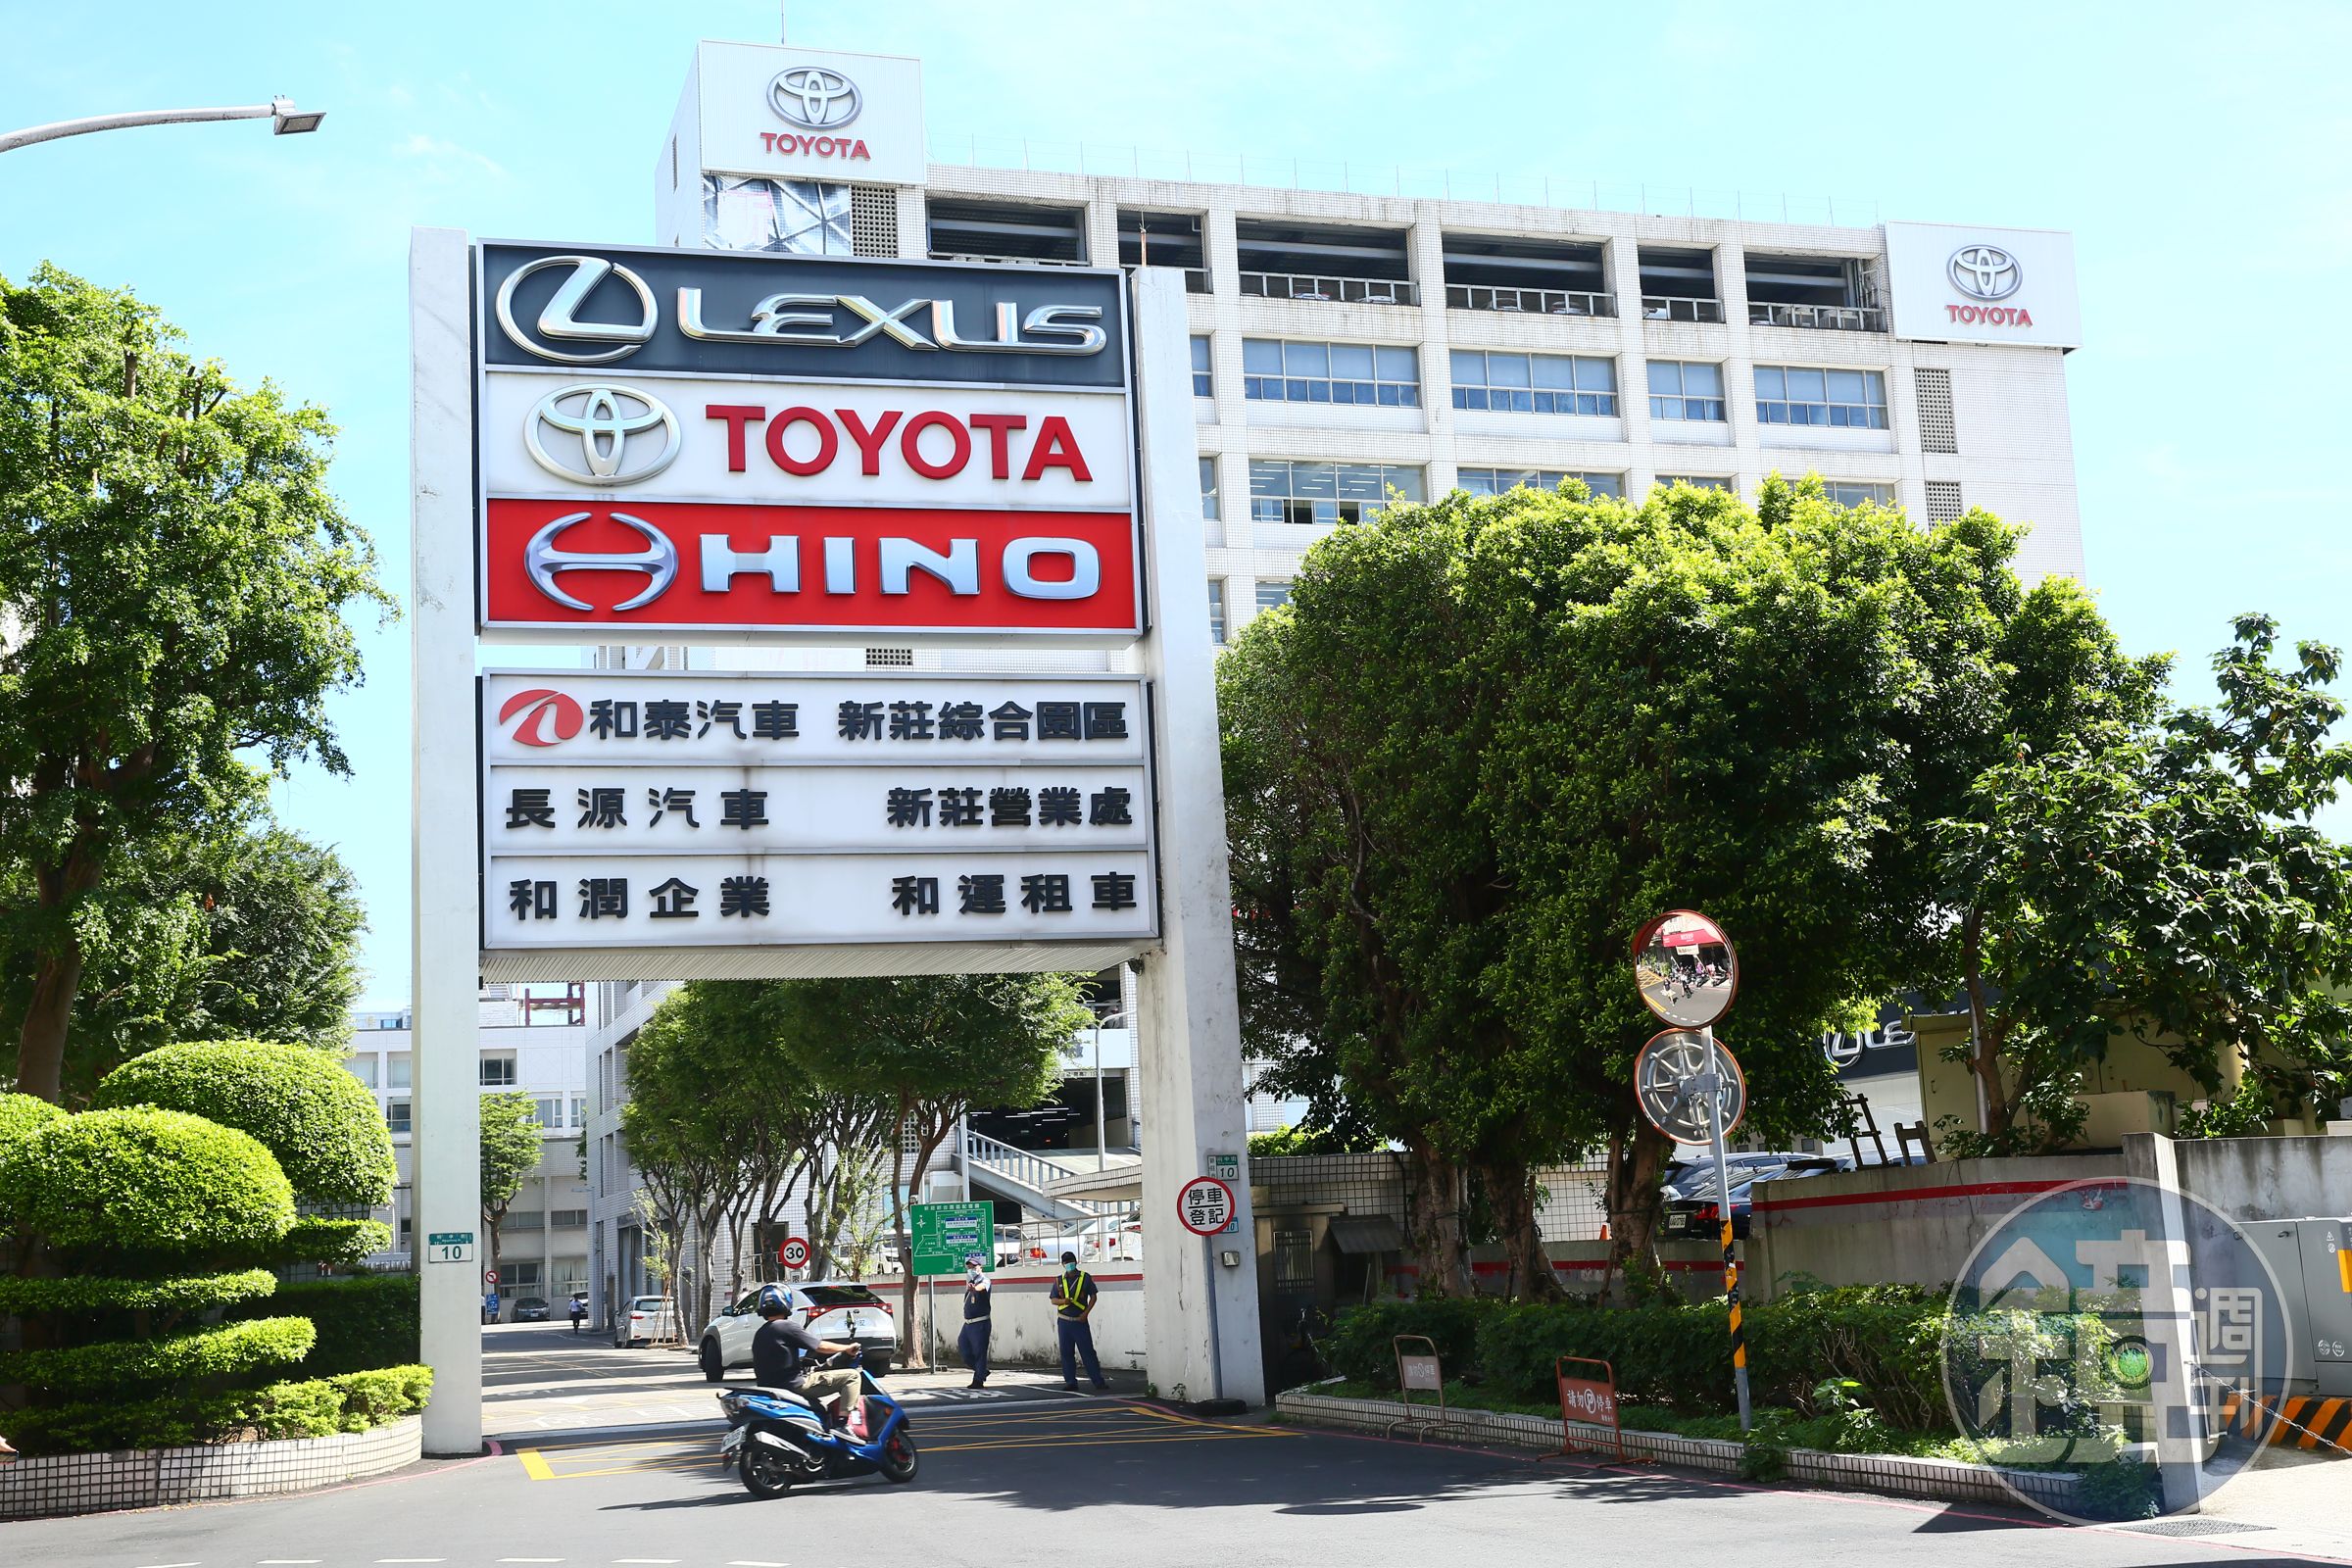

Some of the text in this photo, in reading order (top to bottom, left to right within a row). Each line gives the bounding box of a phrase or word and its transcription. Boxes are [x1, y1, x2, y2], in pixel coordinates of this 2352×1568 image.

[760, 131, 871, 161] TOYOTA
[676, 285, 1108, 357] LEXUS
[1945, 303, 2034, 328] TOYOTA
[705, 404, 1094, 482] TOYOTA
[699, 533, 1102, 600] HINO
[590, 699, 1129, 740] 和泰汽車 新莊綜合園區
[506, 785, 1133, 830] 長源汽車 新莊營業處
[509, 871, 1138, 920] 和潤企業 和運租車
[1220, 1167, 1235, 1178] 10
[1188, 1188, 1223, 1205] 停車
[1190, 1207, 1225, 1226] 登記
[441, 1246, 463, 1260] 10
[786, 1247, 804, 1260] 30
